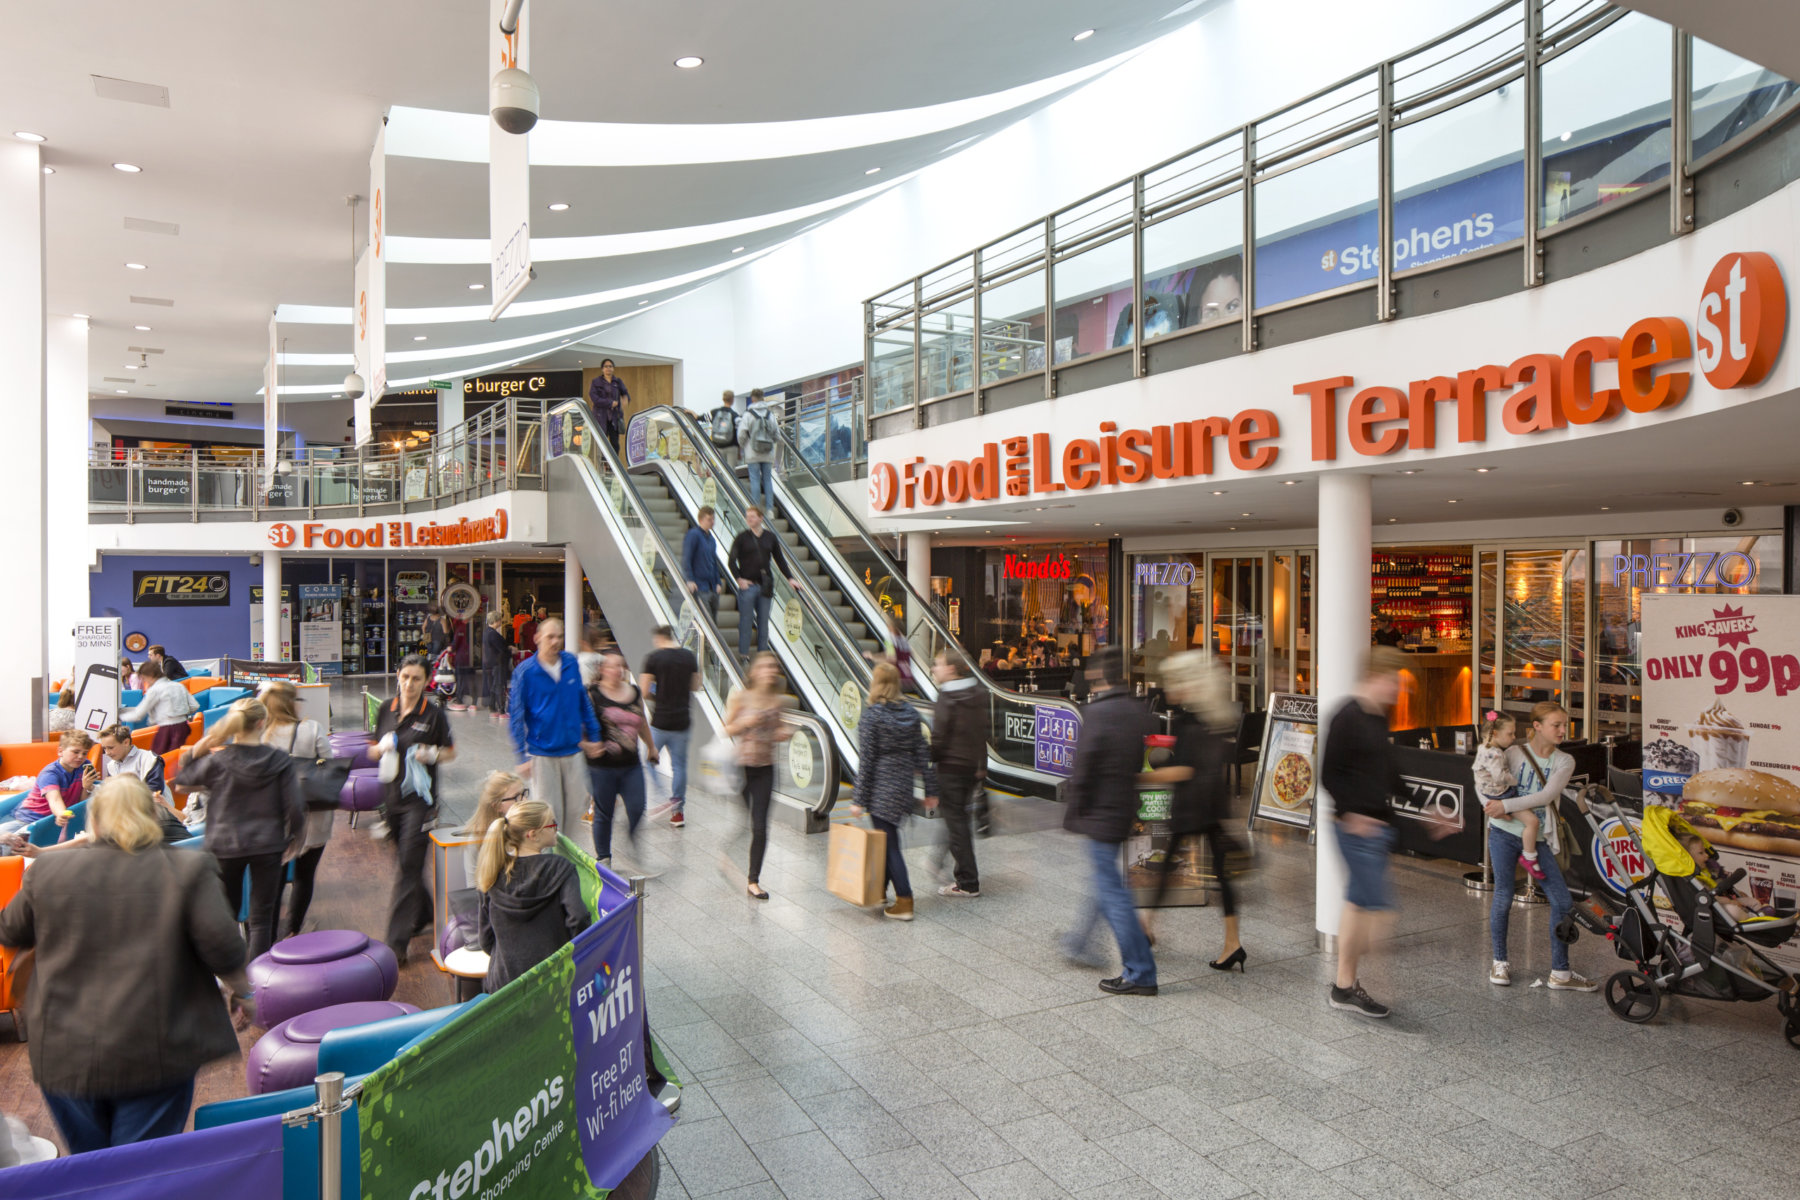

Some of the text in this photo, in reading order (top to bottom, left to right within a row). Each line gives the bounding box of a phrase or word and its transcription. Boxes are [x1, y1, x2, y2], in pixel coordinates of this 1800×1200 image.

[1698, 257, 1746, 373] st
[476, 378, 525, 397] burger
[899, 456, 999, 506] Food
[1001, 436, 1030, 496] and
[1033, 408, 1279, 493] Leisure
[1293, 316, 1692, 461] Terrace
[148, 478, 188, 487] handmade
[148, 486, 177, 495] burger
[268, 525, 289, 544] st
[303, 523, 384, 548] Food
[387, 522, 401, 547] and
[1003, 554, 1071, 580] Nando's
[1135, 562, 1196, 586] PREZZO
[1613, 552, 1757, 588] PREZZO
[139, 576, 208, 595] FIT24
[77, 625, 112, 634] FREE
[1675, 617, 1754, 639] KING SAVERS
[1646, 647, 1800, 697] ONLY 99p
[1007, 716, 1035, 739] PREZ
[1749, 722, 1770, 730] SUNDAE
[1750, 760, 1791, 770] CHEESEBURGER
[1606, 854, 1645, 878] KIN
[577, 979, 594, 1006] BT
[588, 965, 634, 1044] wifi
[591, 1040, 633, 1101] Free BT
[586, 1074, 642, 1141] Wi-fi here
[534, 1119, 564, 1157] Centre
